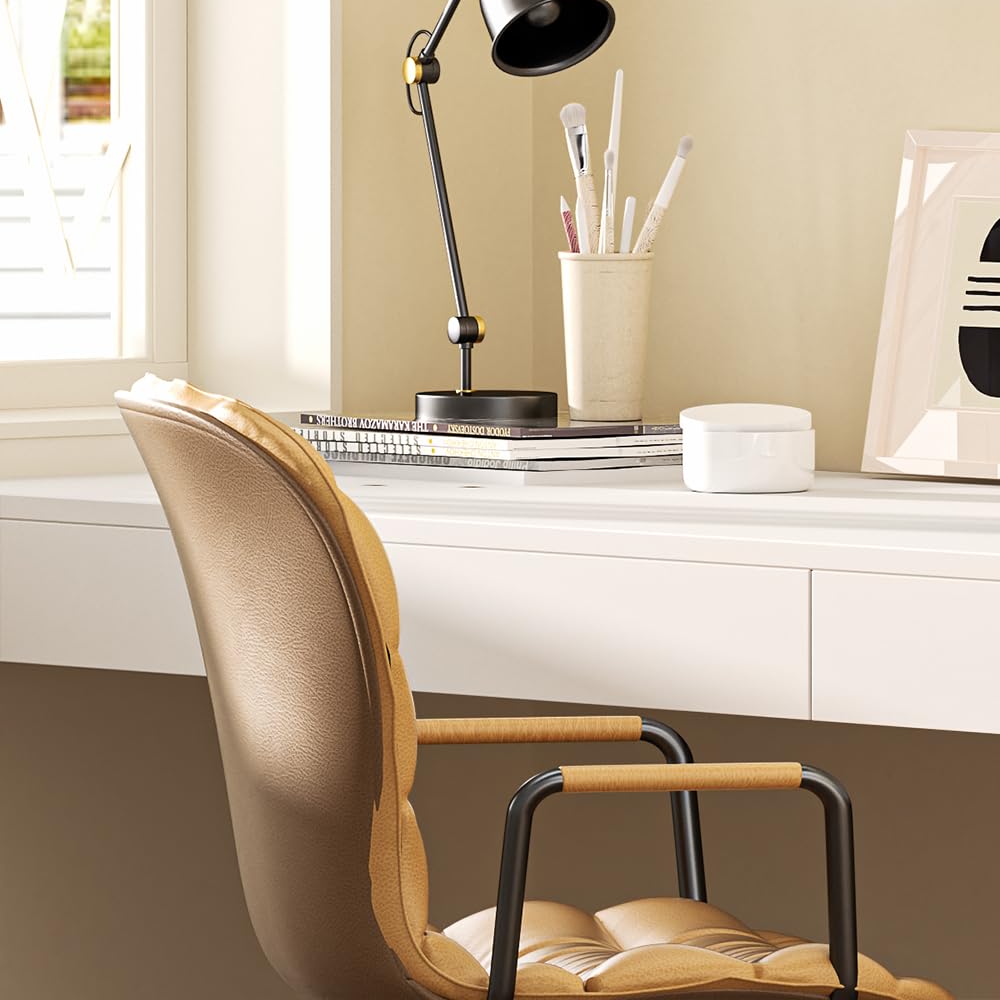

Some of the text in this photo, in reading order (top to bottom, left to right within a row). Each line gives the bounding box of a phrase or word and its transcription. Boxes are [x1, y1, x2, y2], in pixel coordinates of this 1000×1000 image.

[316, 415, 511, 437] FYODOR DOSTOEVSKY THE KARAMAZOV BROTHERS
[294, 429, 345, 442] STORIE
[356, 432, 418, 445] SELECTED
